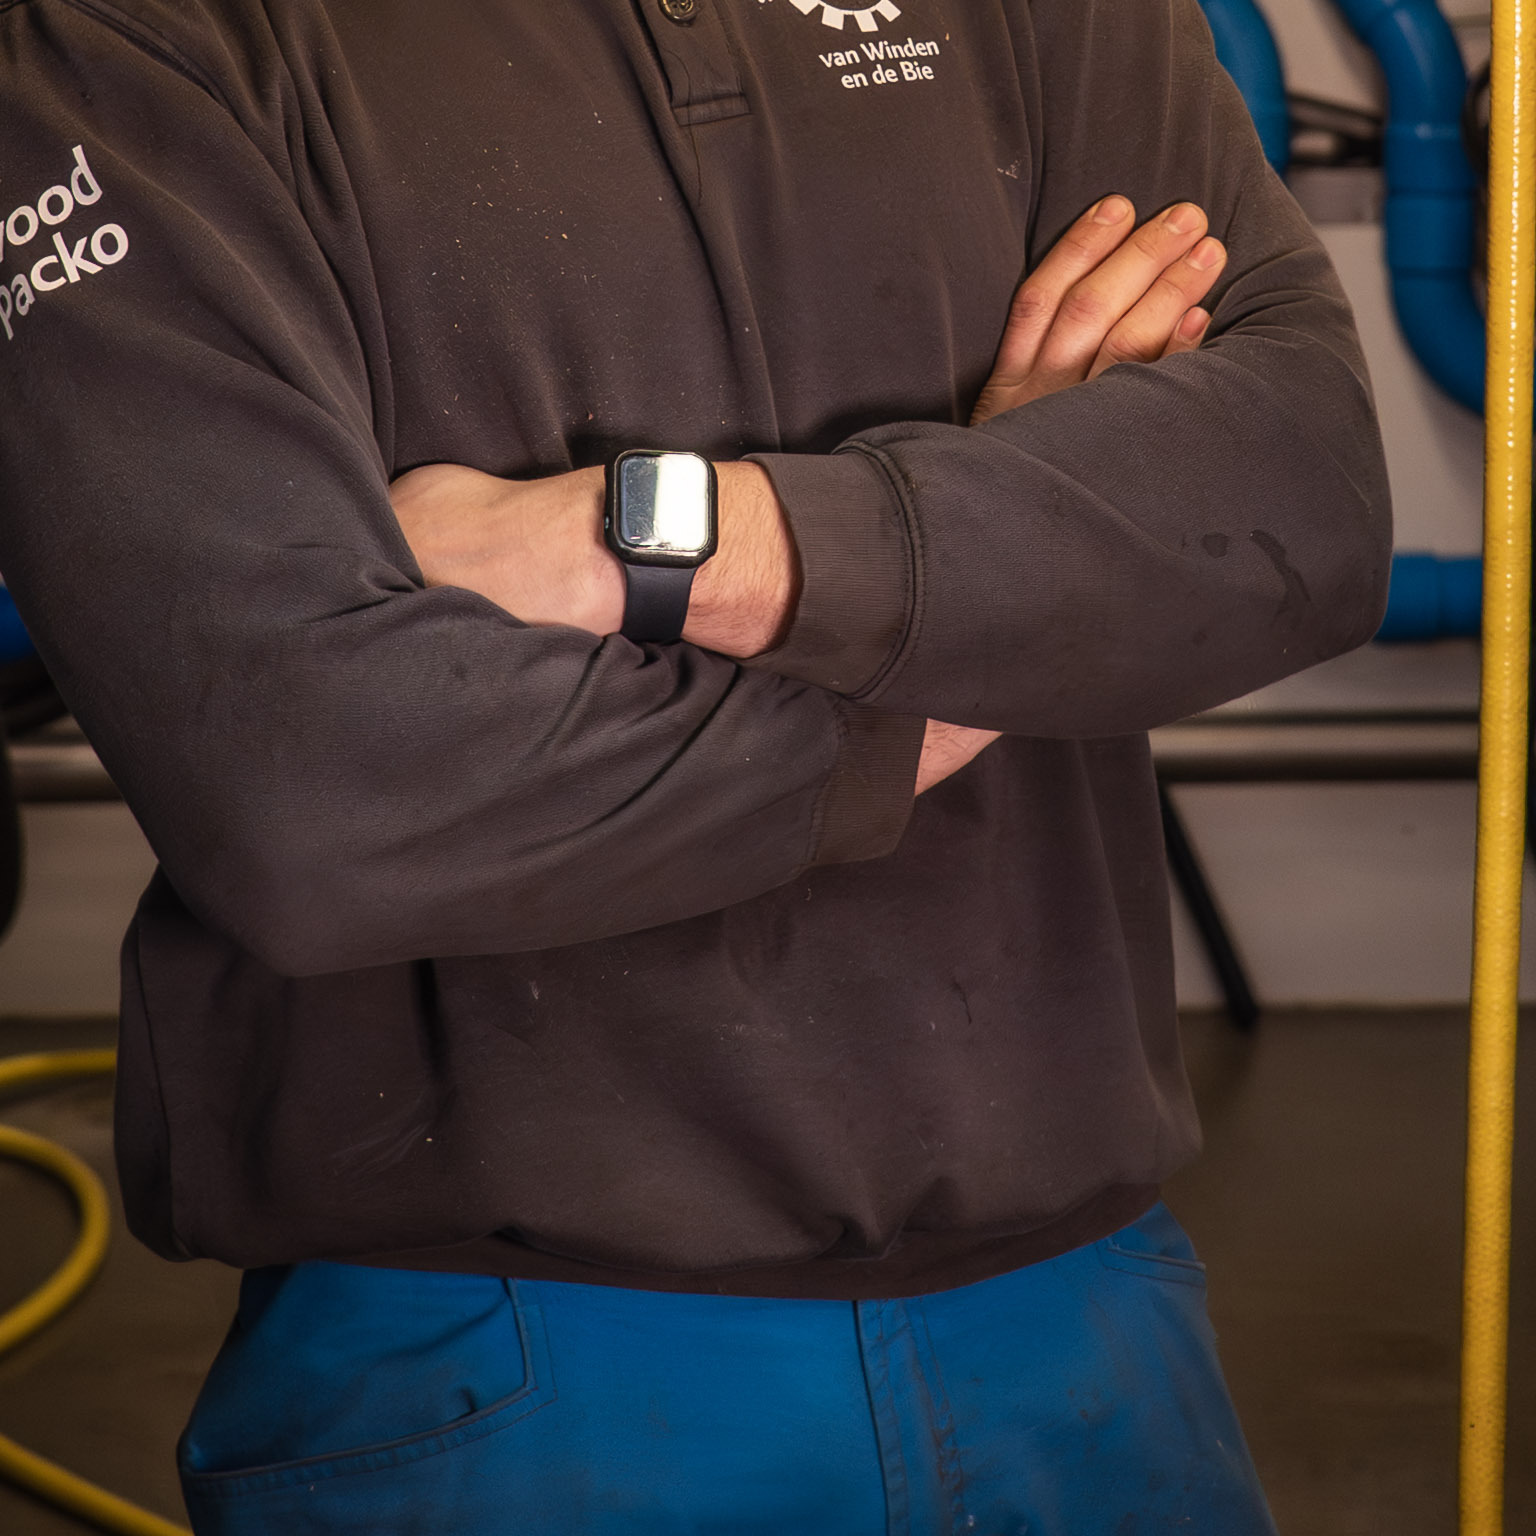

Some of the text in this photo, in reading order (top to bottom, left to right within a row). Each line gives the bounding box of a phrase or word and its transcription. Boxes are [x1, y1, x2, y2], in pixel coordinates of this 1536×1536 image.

[818, 37, 940, 68] van Winden
[840, 60, 935, 89] en de Bie
